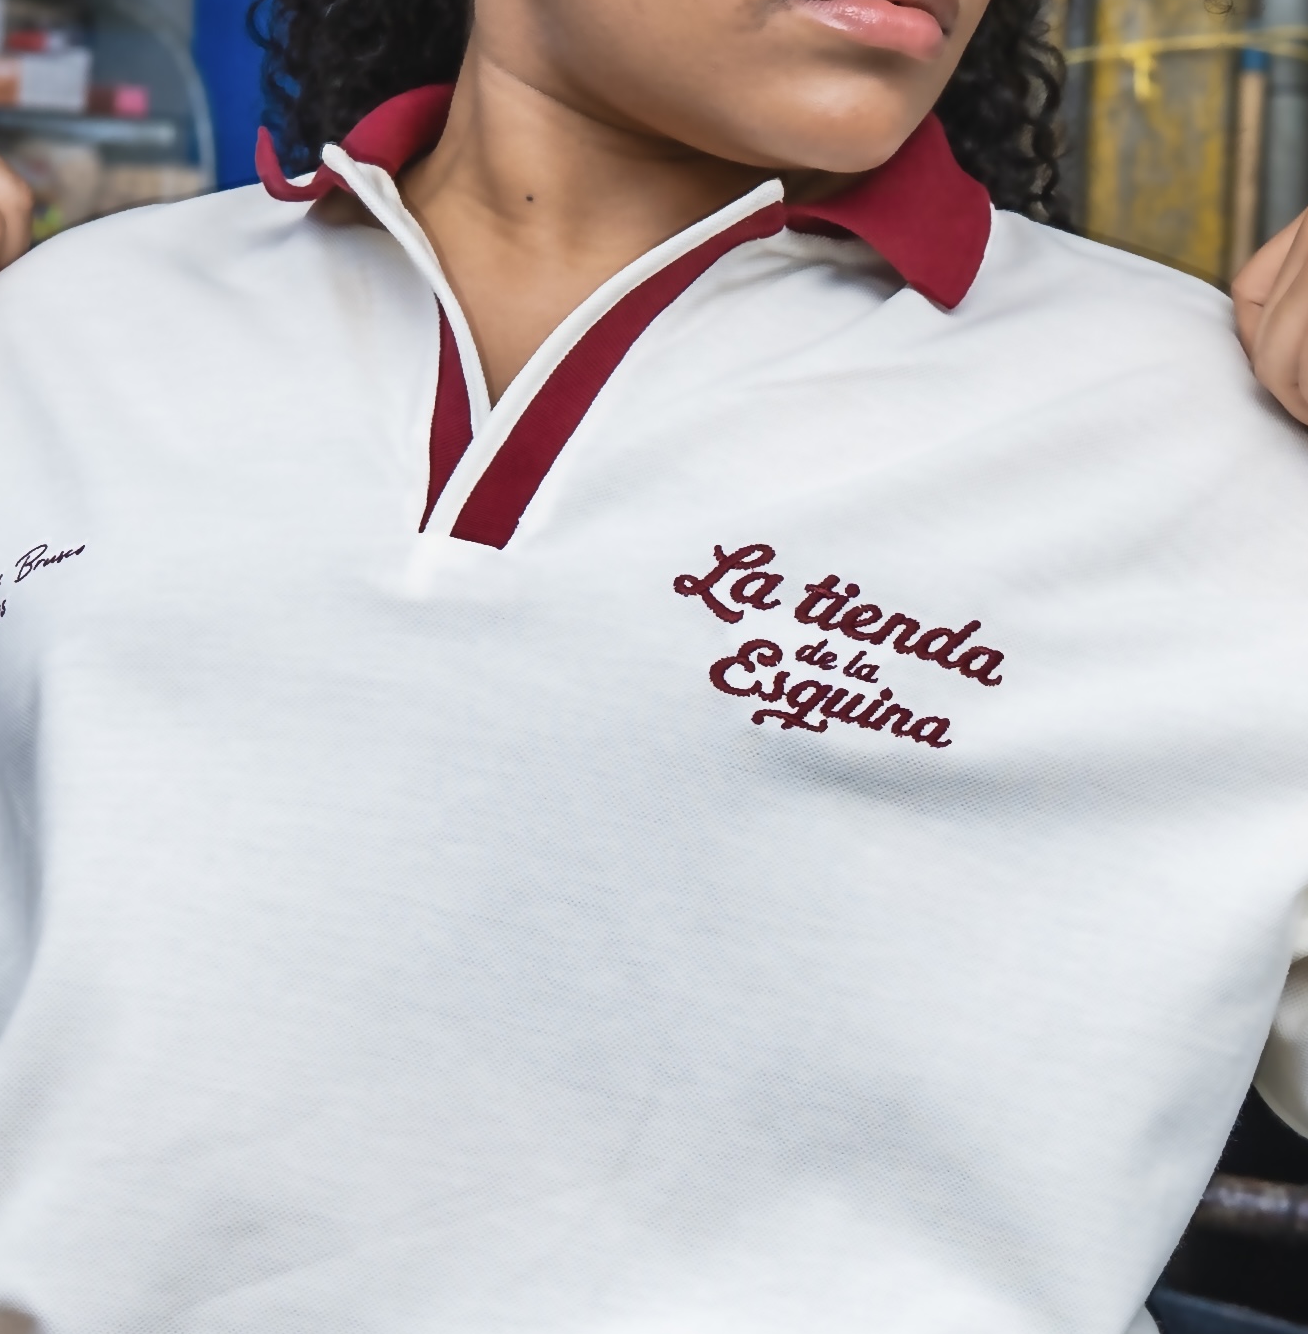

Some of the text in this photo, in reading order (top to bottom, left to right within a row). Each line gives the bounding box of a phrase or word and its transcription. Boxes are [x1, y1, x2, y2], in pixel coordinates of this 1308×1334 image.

[672, 543, 1005, 687] La tienda
[795, 638, 881, 684] de la
[708, 638, 953, 749] Esquina
